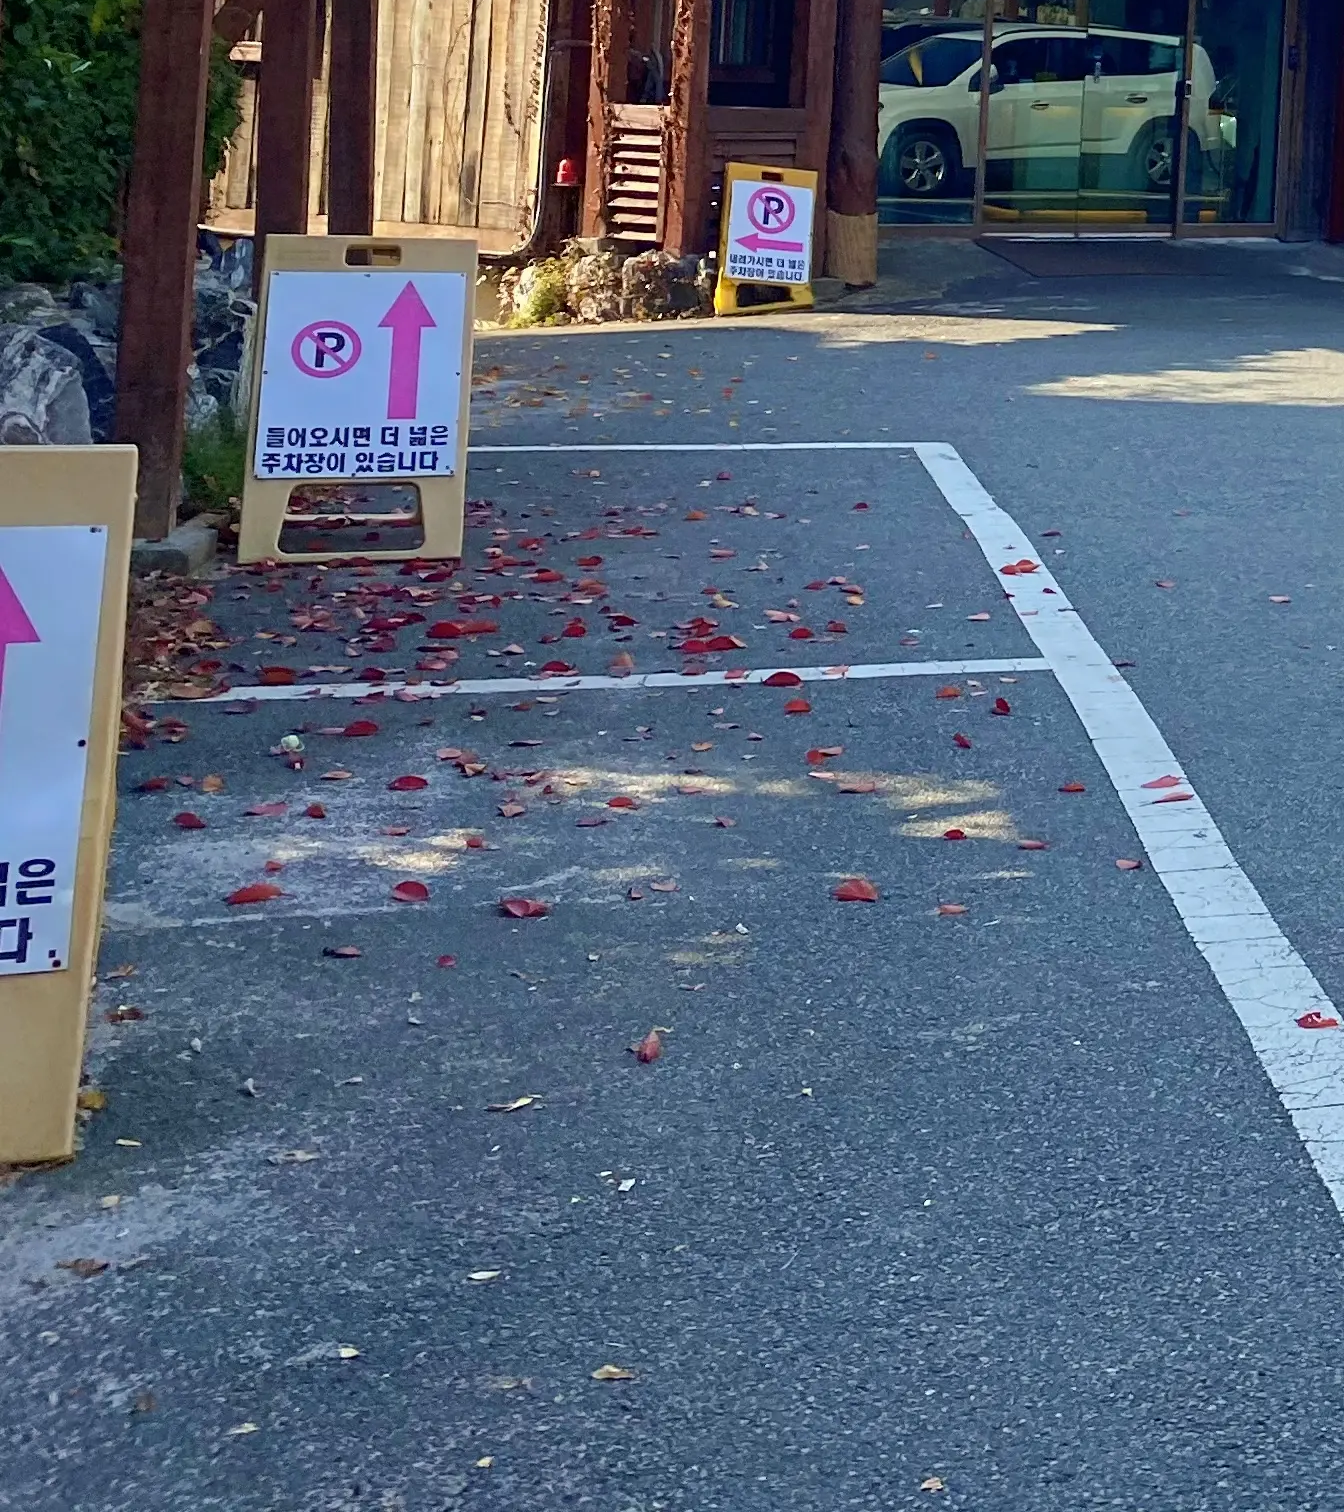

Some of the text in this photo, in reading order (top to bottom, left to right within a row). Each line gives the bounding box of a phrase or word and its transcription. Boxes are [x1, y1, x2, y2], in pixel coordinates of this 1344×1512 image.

[731, 265, 764, 278] 주차장이
[777, 258, 785, 268] 더
[266, 425, 449, 448] 들어오시면 더 넓은
[261, 452, 345, 474] 주차장이
